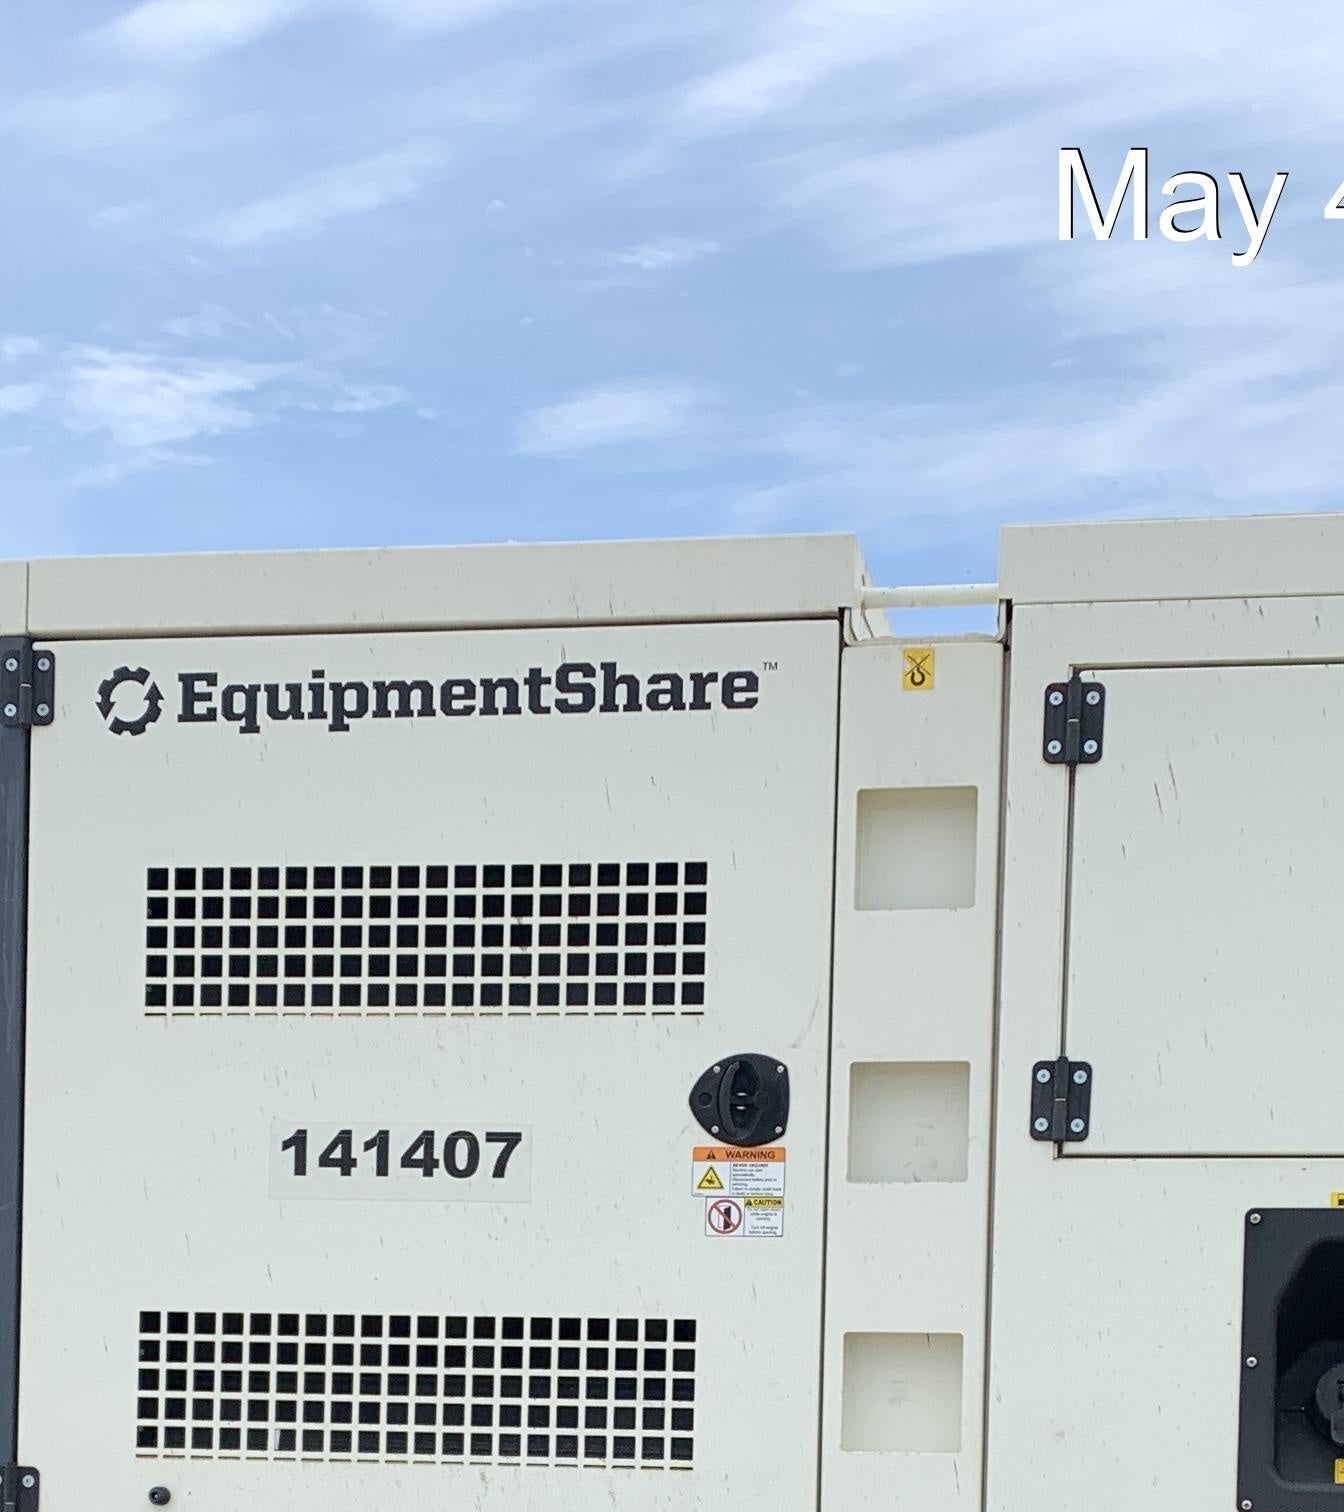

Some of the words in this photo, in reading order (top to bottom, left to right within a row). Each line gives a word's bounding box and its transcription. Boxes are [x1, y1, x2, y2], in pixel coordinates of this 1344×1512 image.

[177, 662, 759, 734] EquipmentShare
[282, 1129, 522, 1179] 141407
[725, 1150, 776, 1160] WARNING
